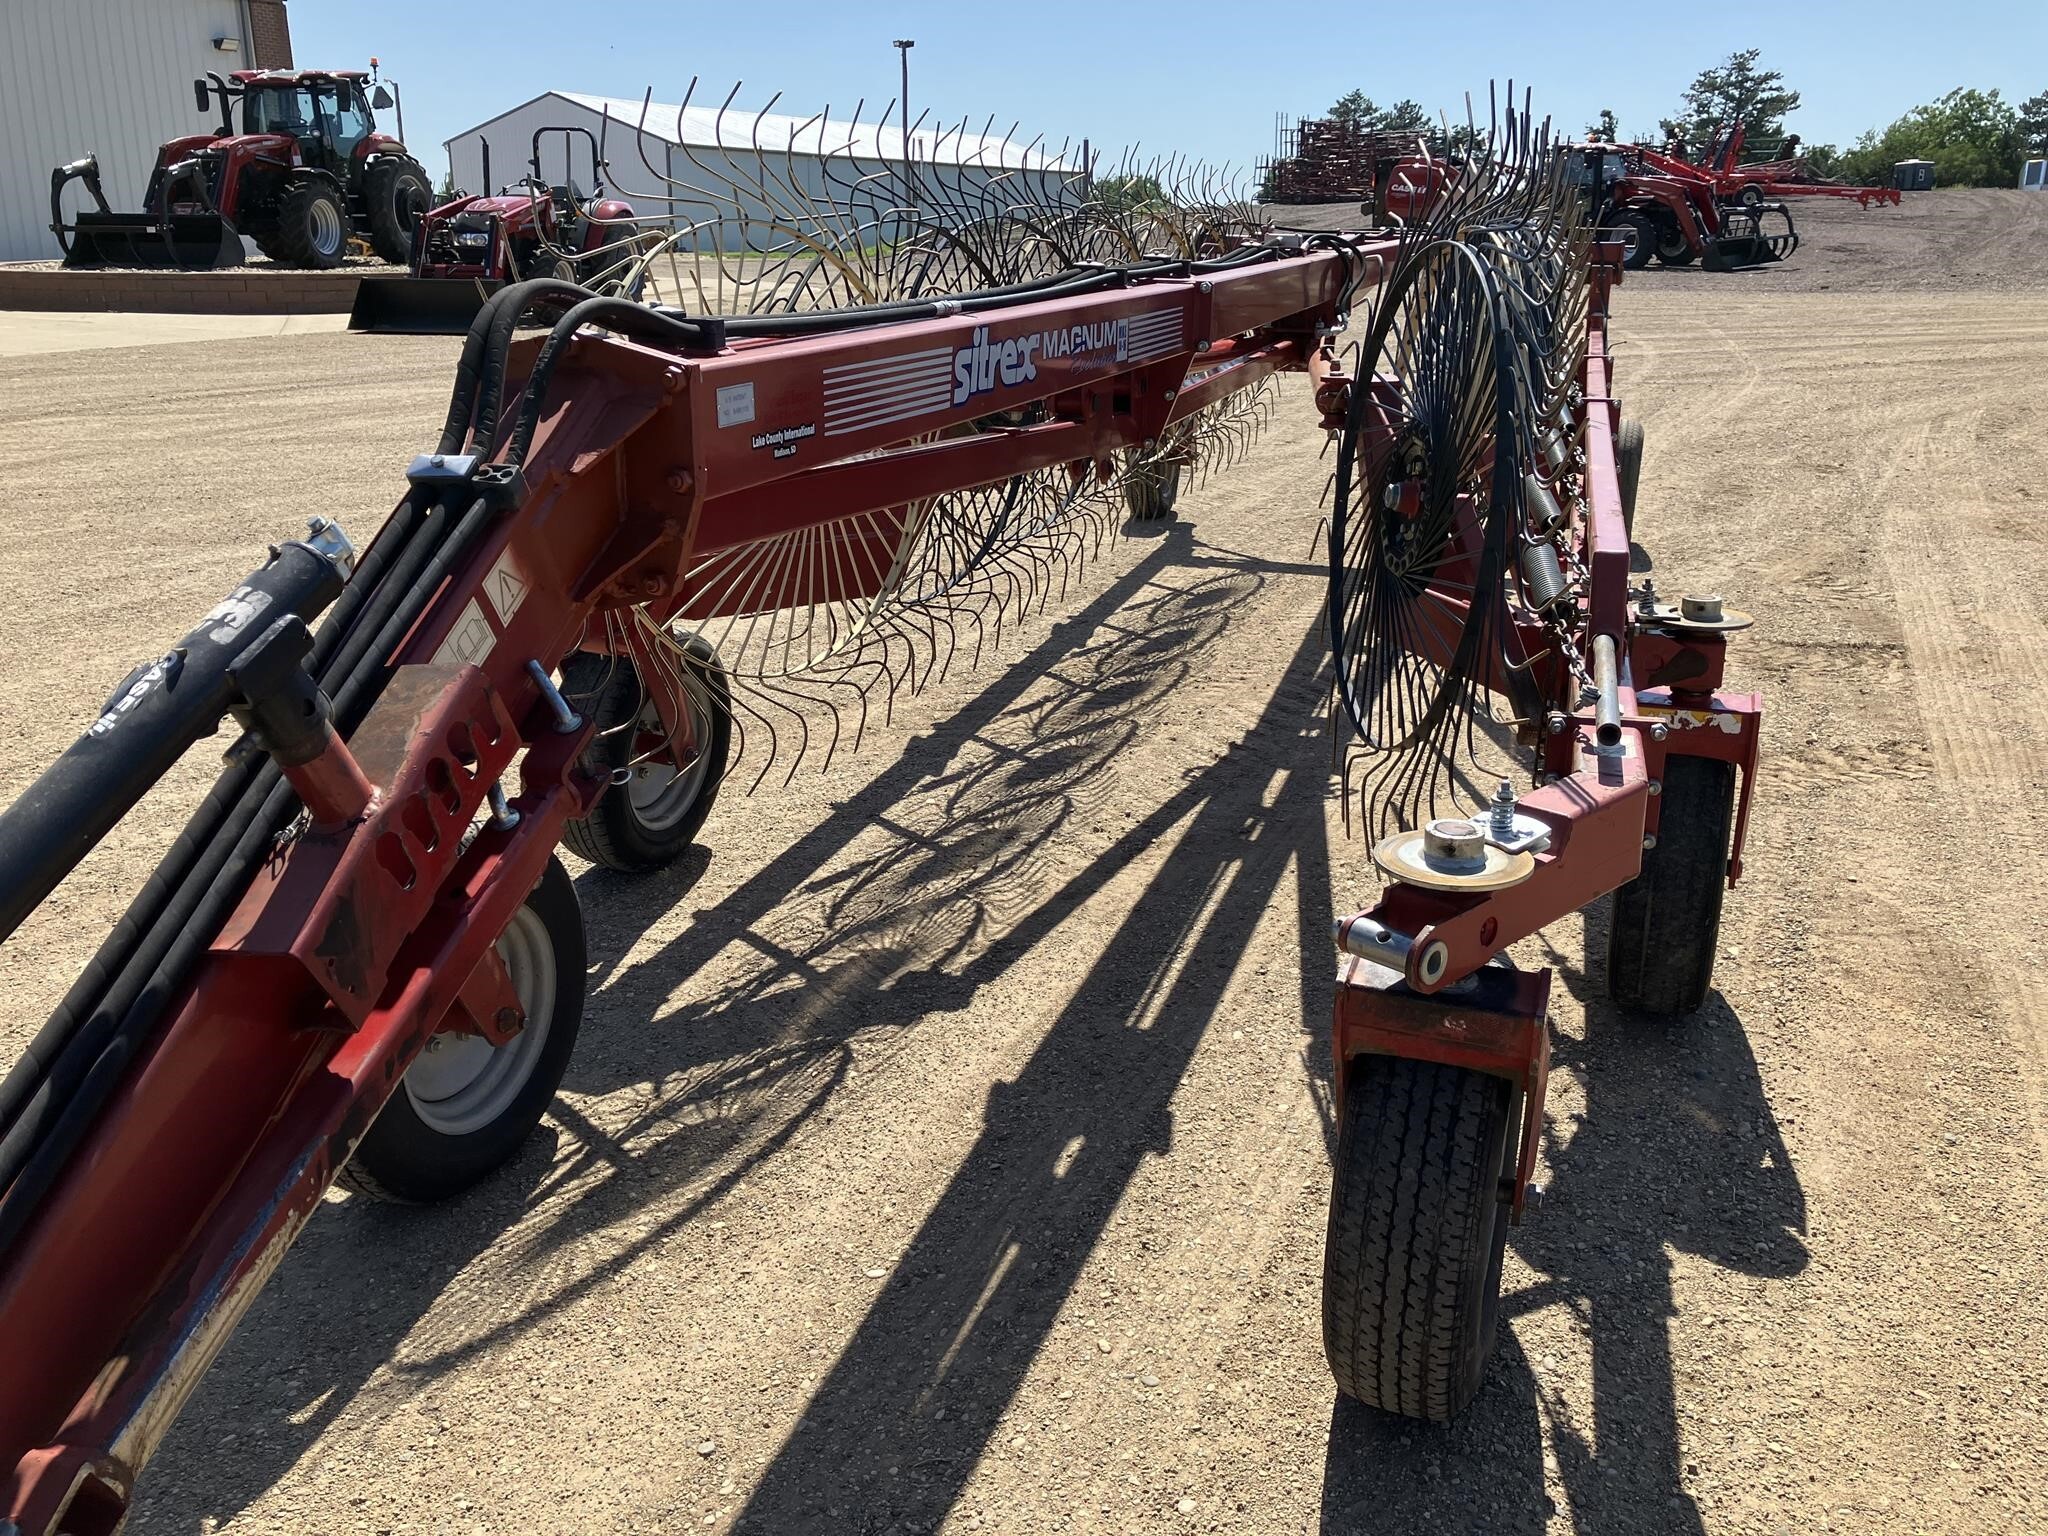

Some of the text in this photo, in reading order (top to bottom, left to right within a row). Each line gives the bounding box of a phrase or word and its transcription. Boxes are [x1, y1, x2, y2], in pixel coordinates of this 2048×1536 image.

[954, 325, 1041, 404] sitrex
[1043, 320, 1117, 360] MAGNUM
[752, 423, 814, 448] Lake County International
[117, 651, 178, 711] CASE
